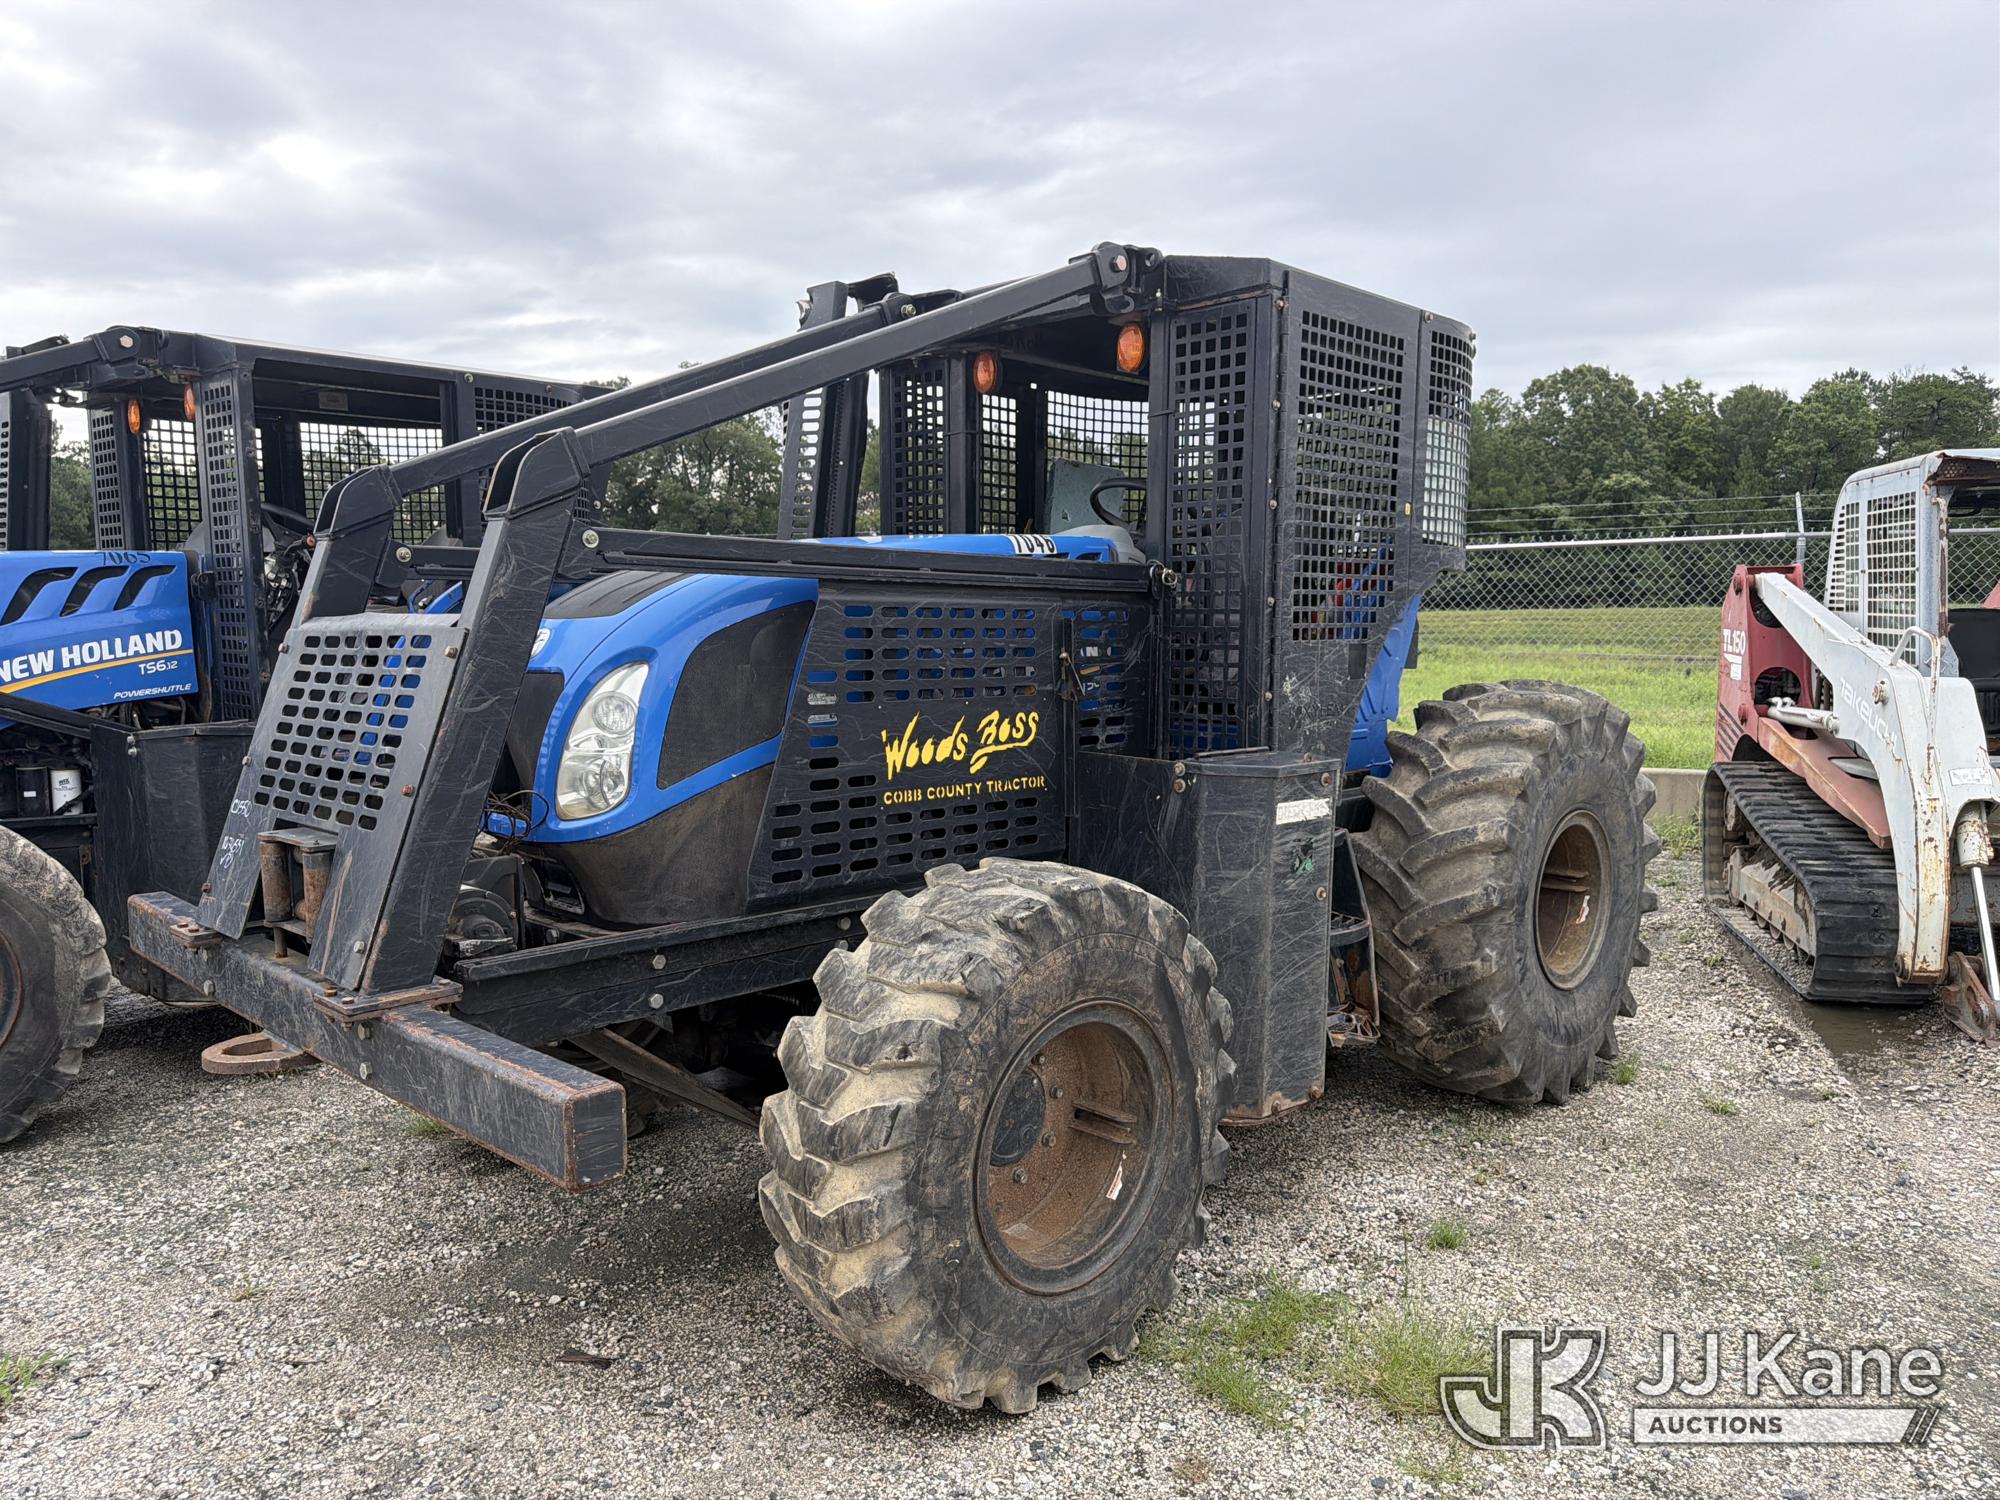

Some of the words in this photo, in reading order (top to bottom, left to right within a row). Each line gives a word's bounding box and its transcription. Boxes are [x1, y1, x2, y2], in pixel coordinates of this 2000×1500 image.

[61, 629, 183, 666] HOLLAND
[1723, 628, 1746, 655] TL150
[113, 683, 192, 699] POWERSHUTTLE
[881, 711, 969, 780] Woods
[883, 789, 922, 805] COBB
[927, 782, 982, 799] COUNTY
[986, 775, 1046, 794] TRACTOR
